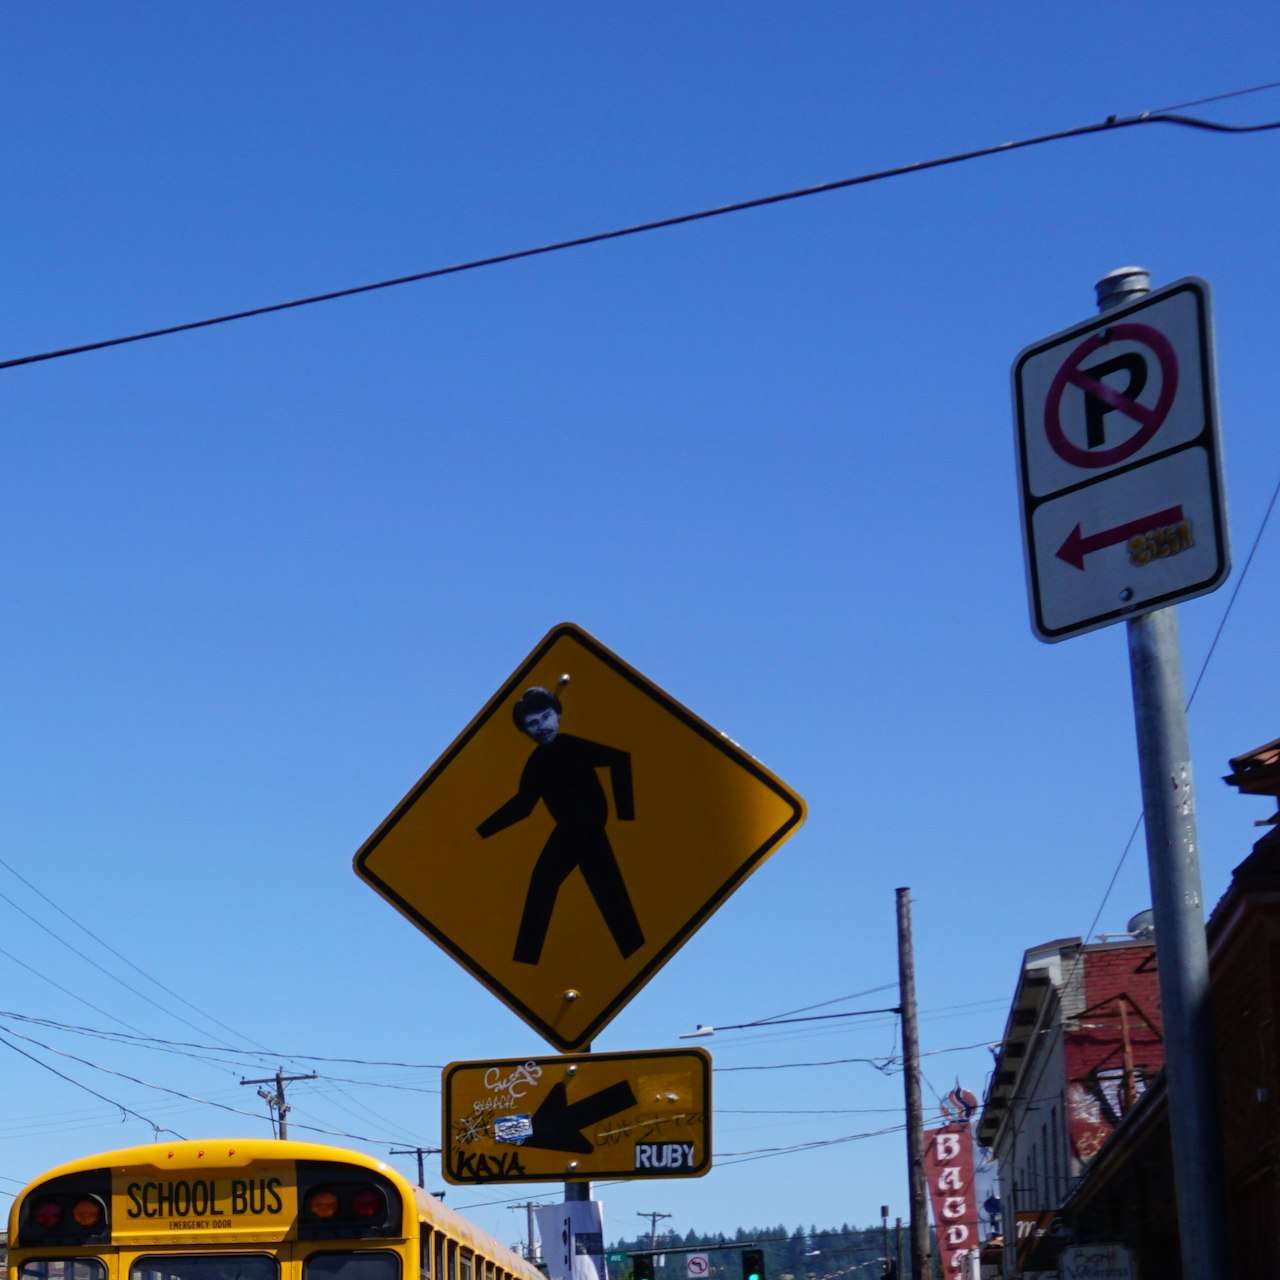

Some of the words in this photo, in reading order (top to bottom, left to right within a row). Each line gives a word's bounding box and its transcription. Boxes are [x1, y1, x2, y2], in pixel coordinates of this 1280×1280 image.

[457, 1150, 525, 1177] KAYA
[636, 1144, 696, 1169] RUBY
[127, 1180, 224, 1218] SCHOOL
[231, 1178, 283, 1214] BUS
[169, 1221, 210, 1230] EMERGENCY
[213, 1219, 232, 1228] DOOR
